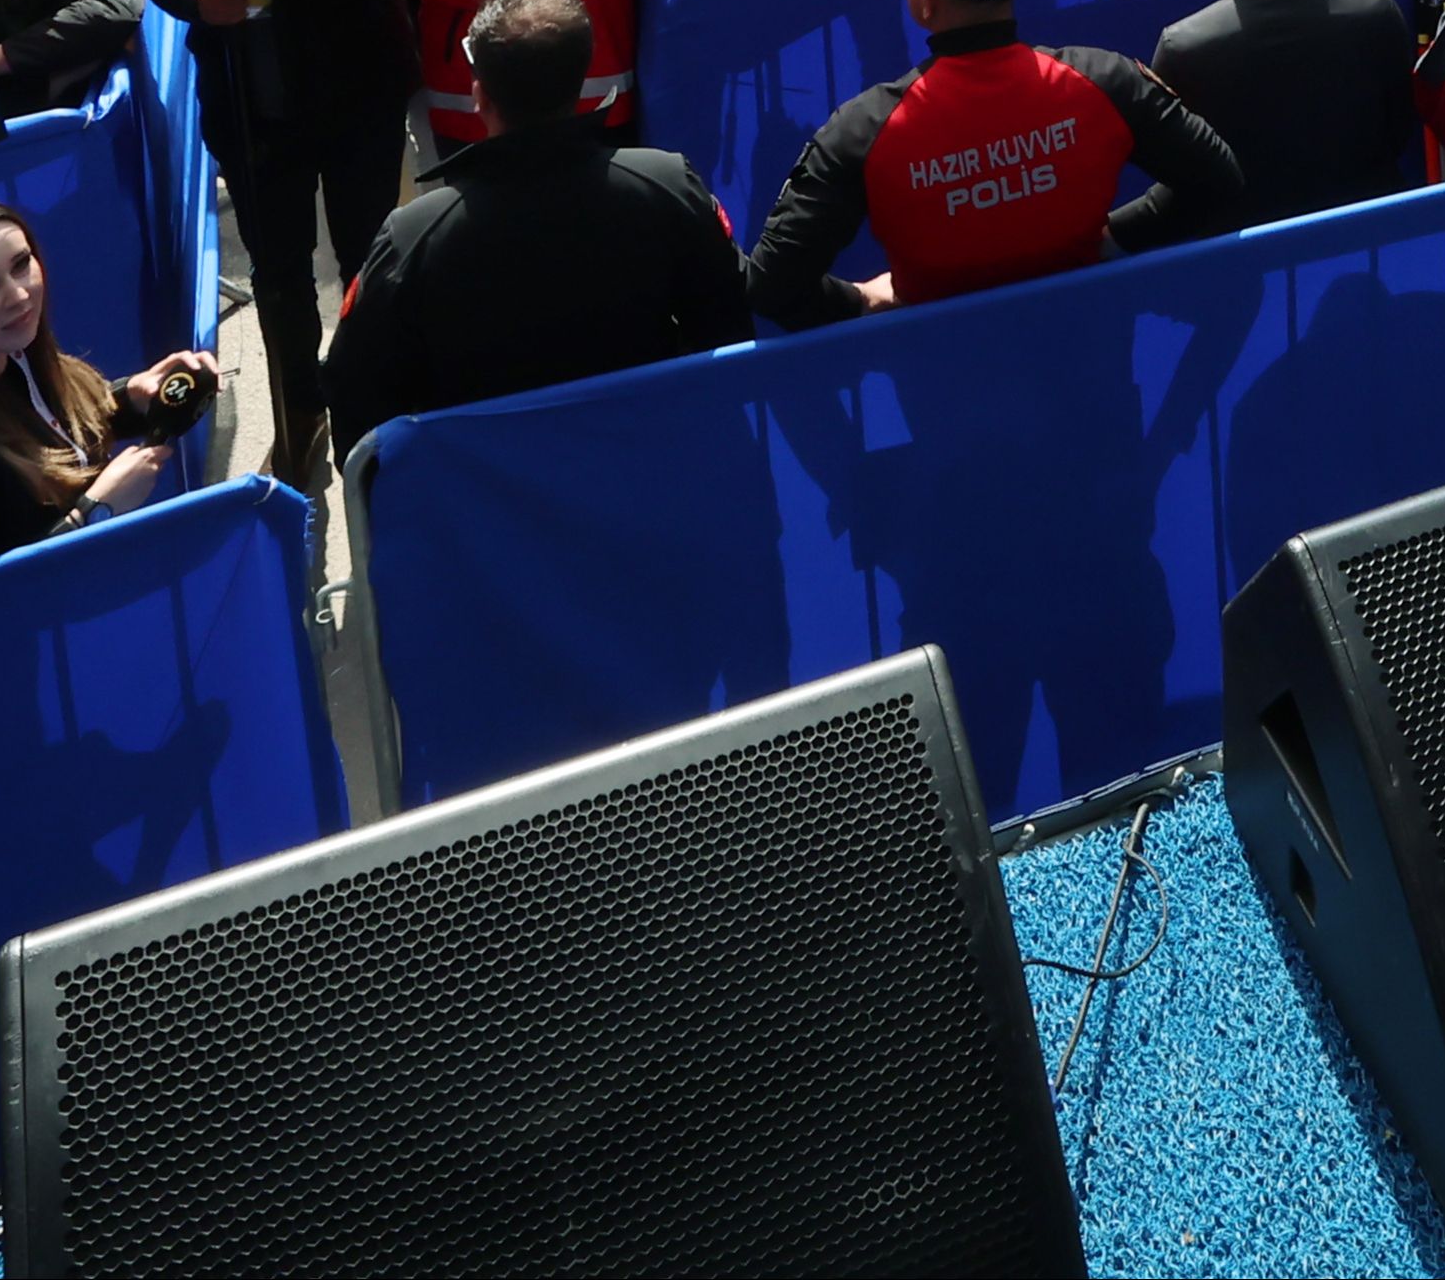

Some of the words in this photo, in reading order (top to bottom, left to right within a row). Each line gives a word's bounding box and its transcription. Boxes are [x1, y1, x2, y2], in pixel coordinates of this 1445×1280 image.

[909, 147, 980, 190] HAZIR
[986, 117, 1076, 170] KUVVET
[946, 163, 1058, 217] POLİS
[164, 379, 189, 400] 24
